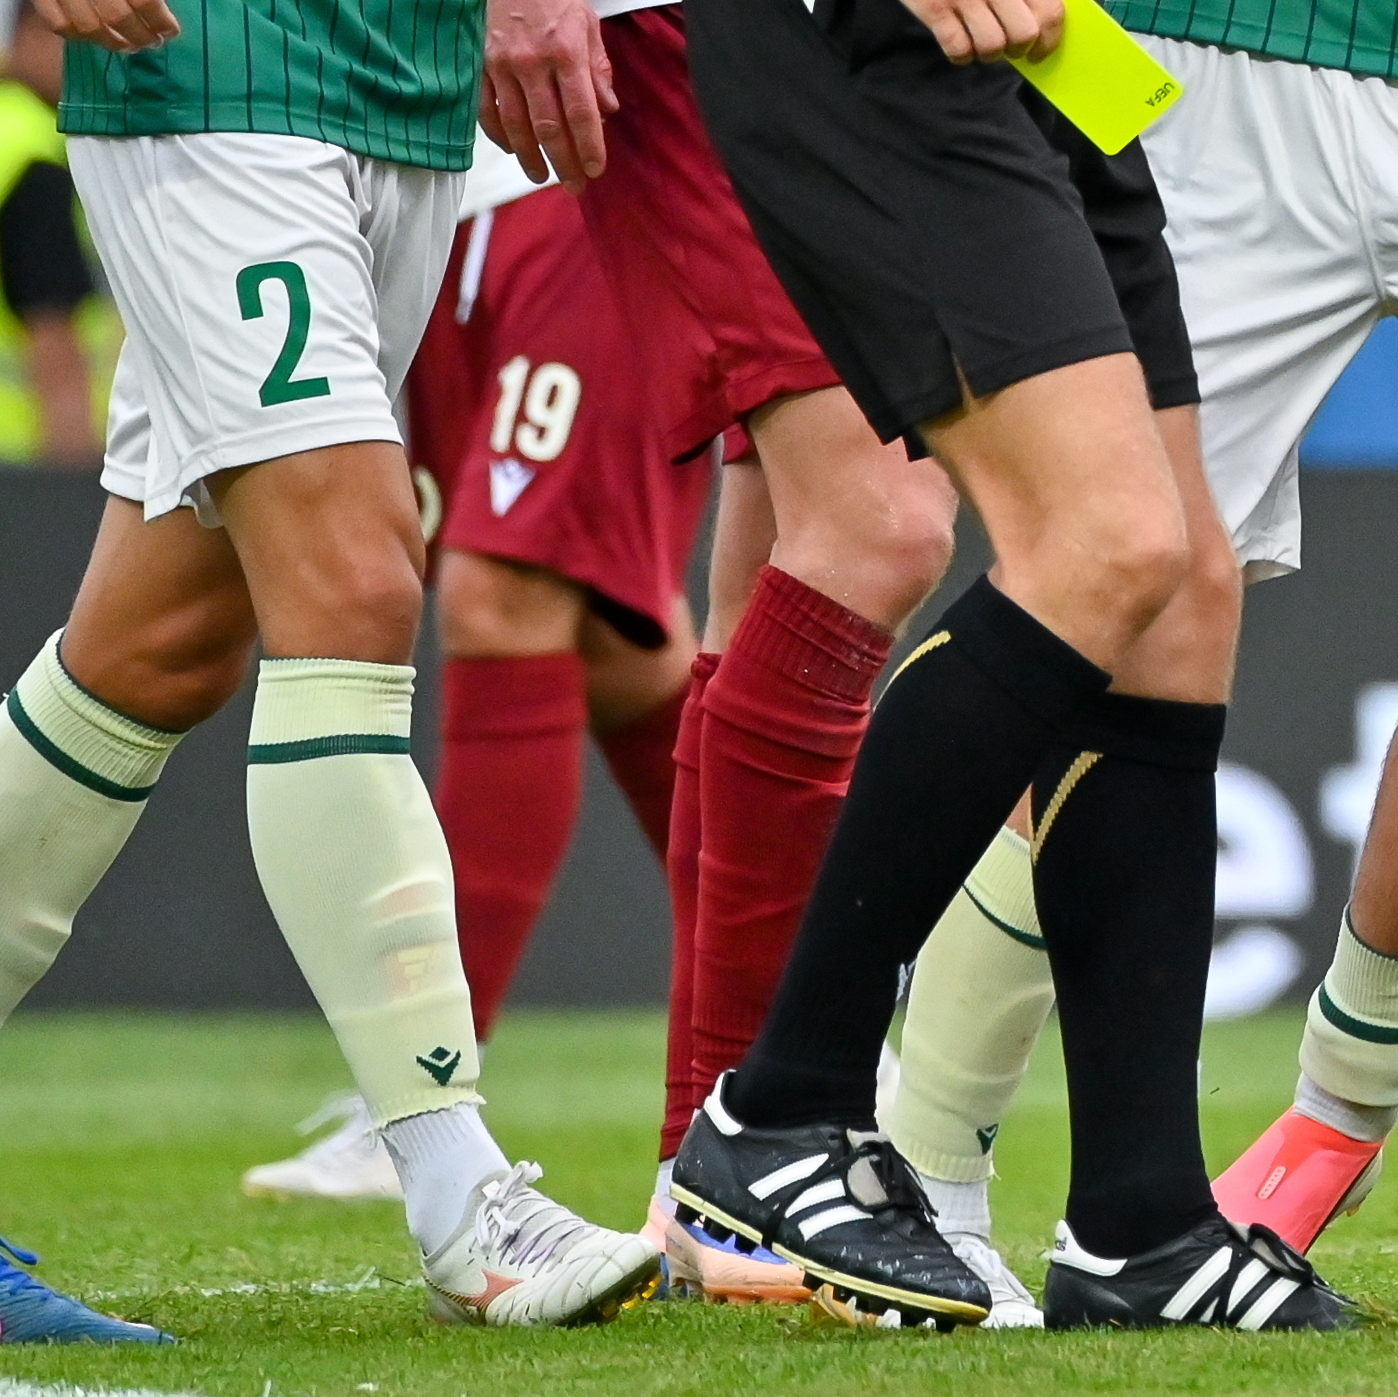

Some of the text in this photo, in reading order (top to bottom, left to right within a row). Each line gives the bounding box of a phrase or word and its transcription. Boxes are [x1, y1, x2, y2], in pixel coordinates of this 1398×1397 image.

[1144, 82, 1176, 107] UEFA
[235, 260, 332, 408] 2
[489, 354, 583, 463] 19
